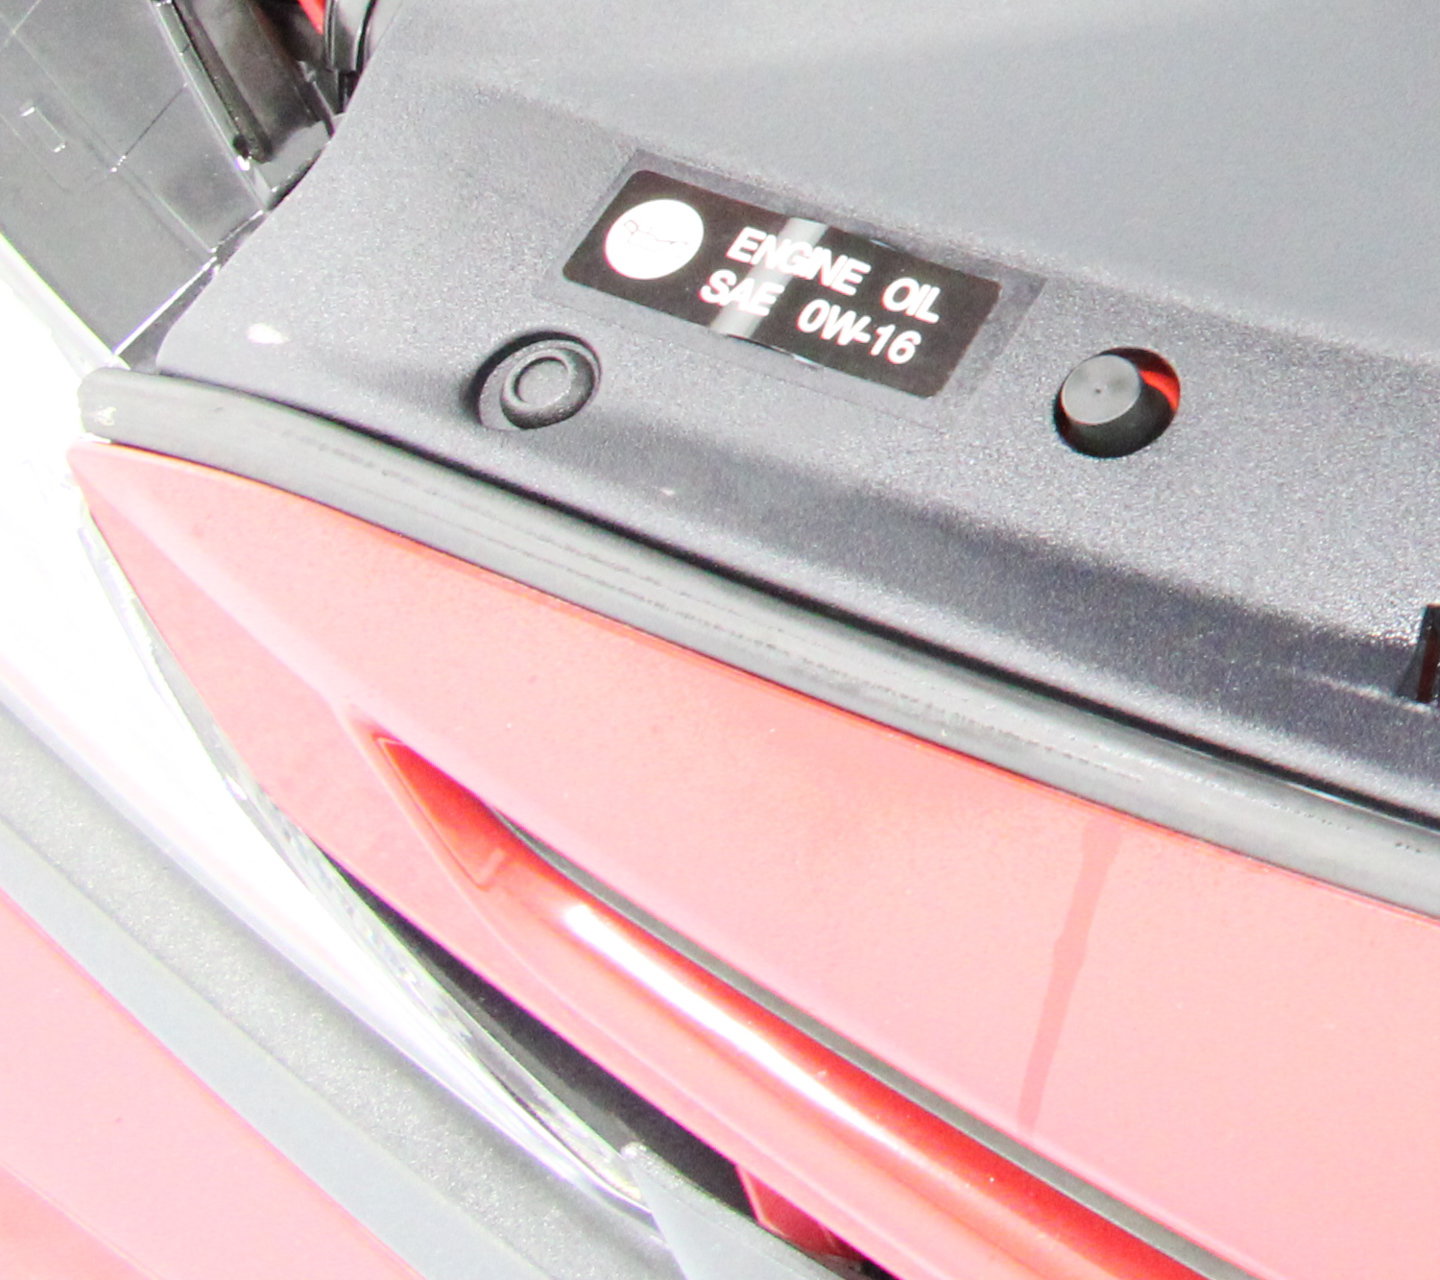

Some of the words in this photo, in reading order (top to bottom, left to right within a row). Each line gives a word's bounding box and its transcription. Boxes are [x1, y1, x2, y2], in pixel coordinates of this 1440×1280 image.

[698, 269, 782, 318] SAE
[796, 297, 923, 366] 0W-16
[725, 226, 871, 296] ENGINE
[881, 276, 944, 324] OIL
